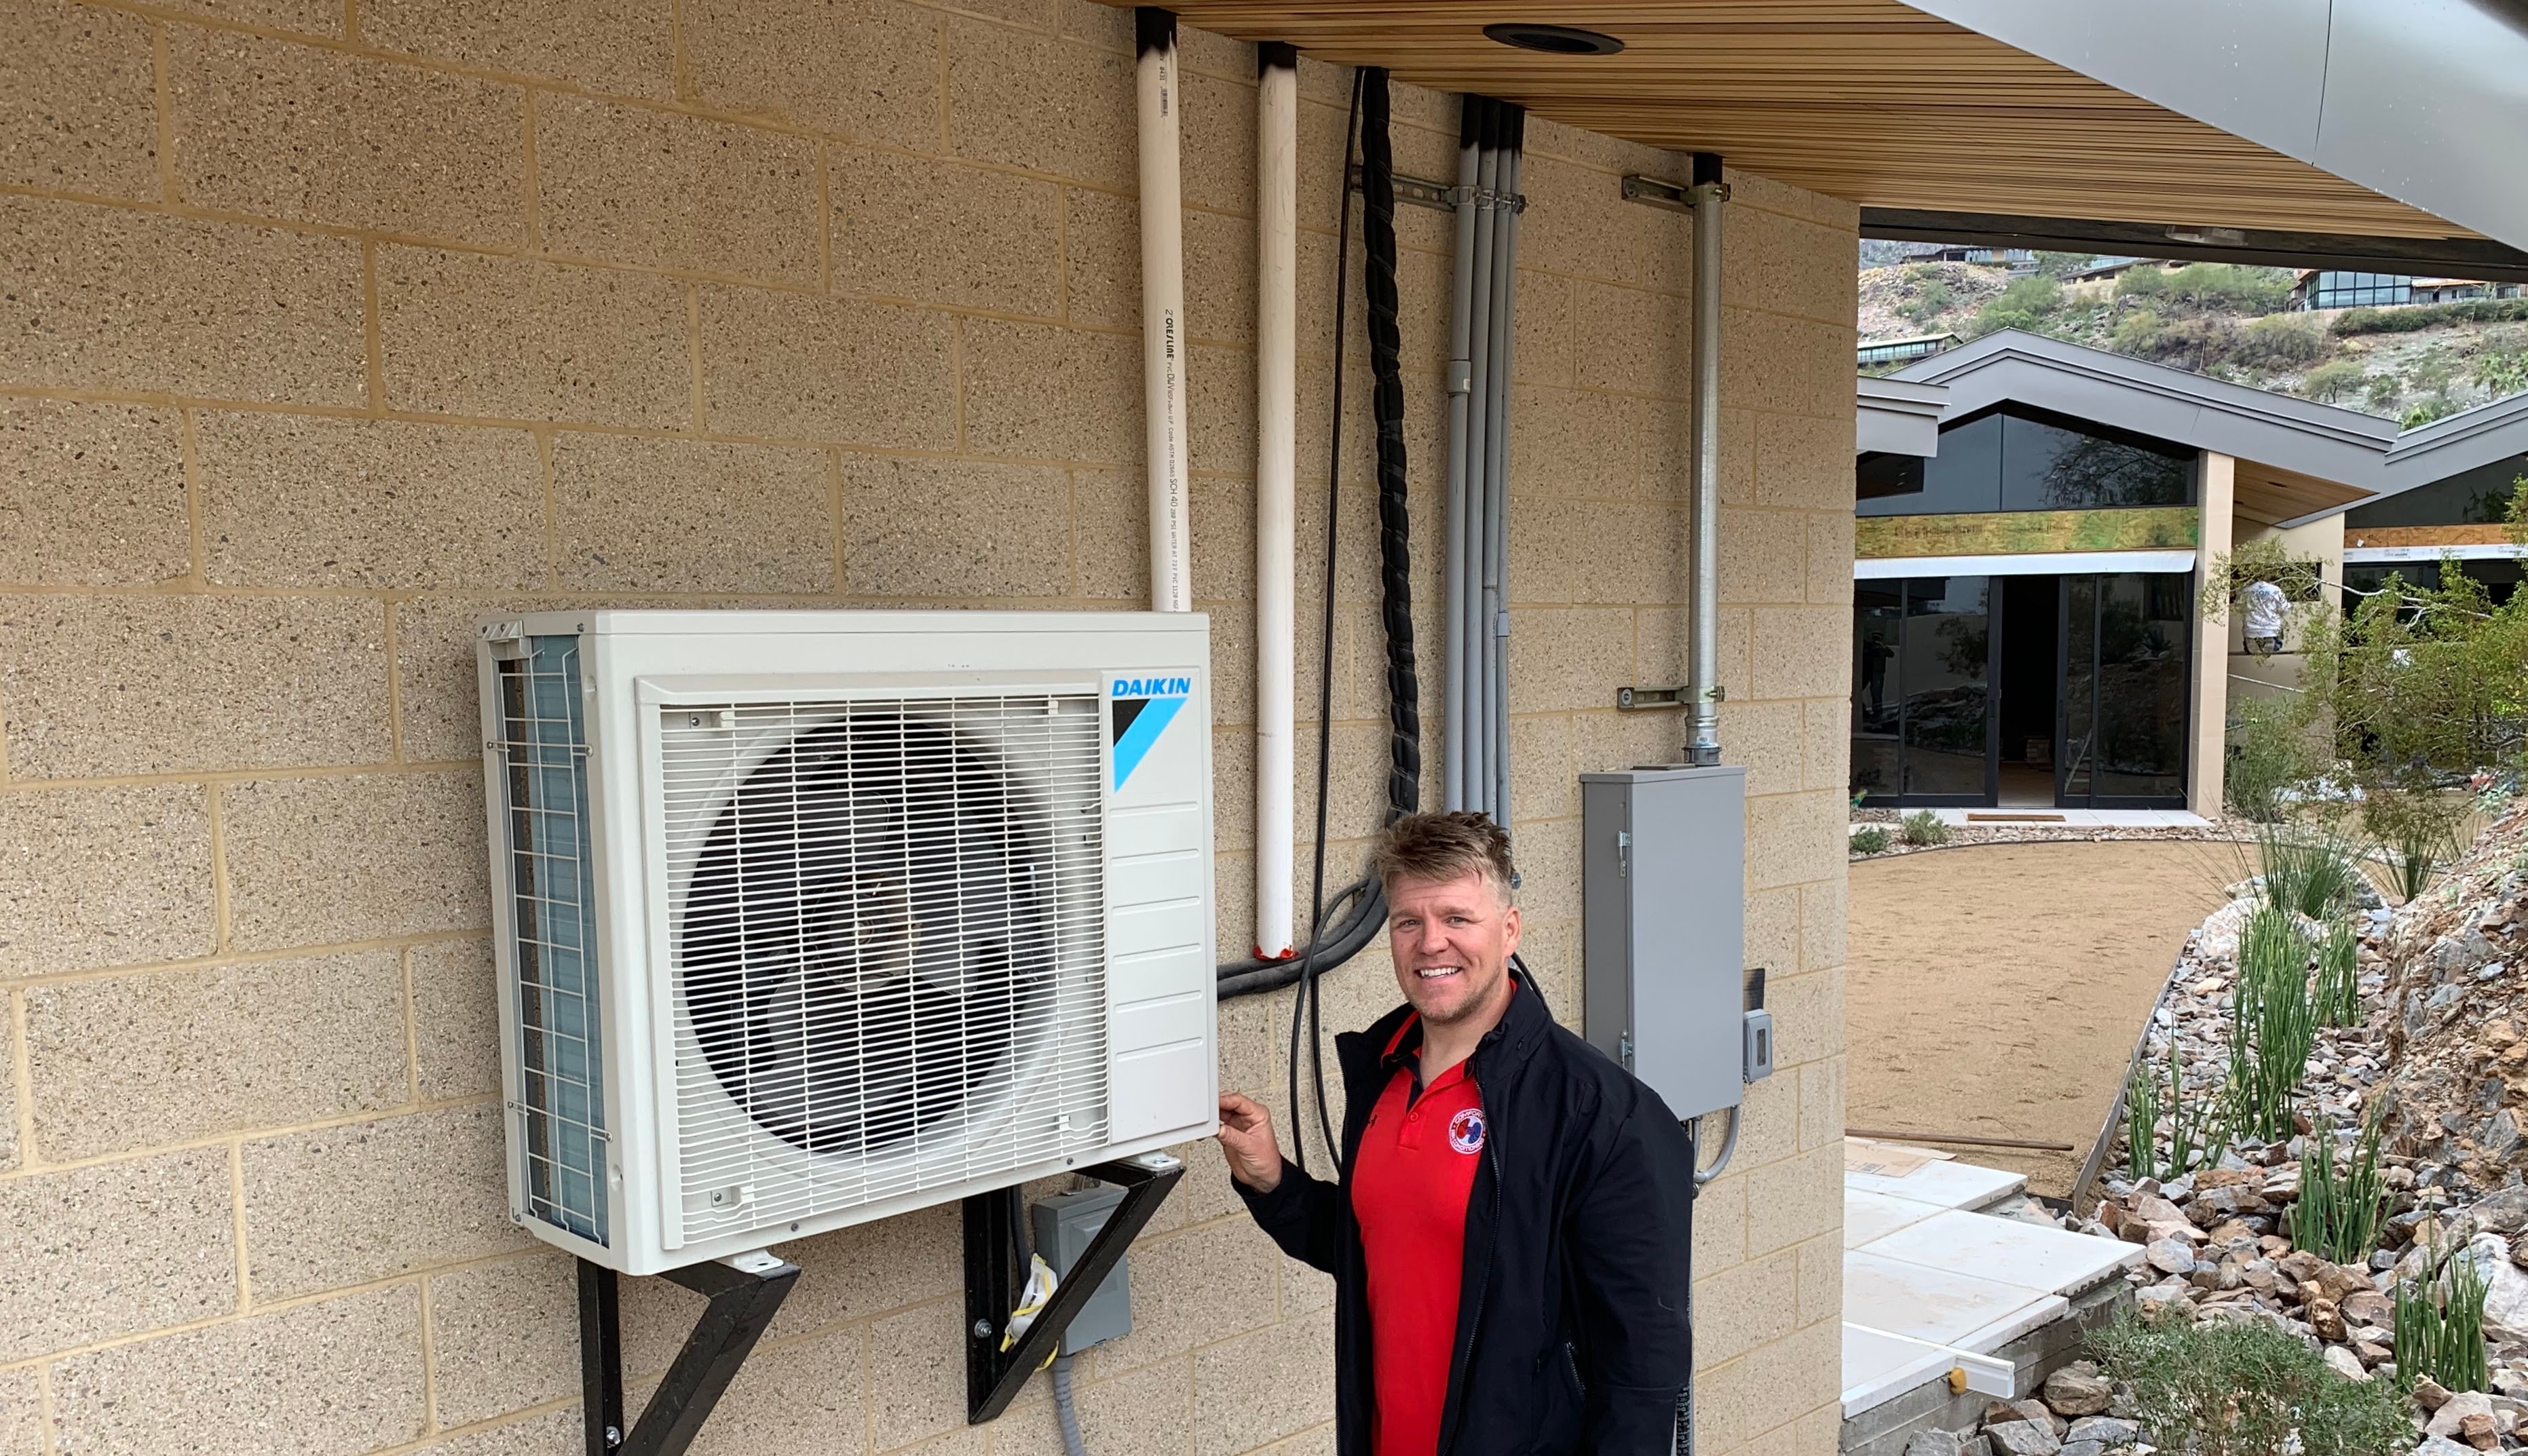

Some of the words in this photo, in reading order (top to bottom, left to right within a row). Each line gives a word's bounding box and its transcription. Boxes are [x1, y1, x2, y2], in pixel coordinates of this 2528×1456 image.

[1167, 373, 1175, 391] DWV
[1169, 478, 1178, 495] SCH
[1170, 495, 1179, 507] 40
[1171, 550, 1177, 559] AT
[1112, 677, 1192, 697] DAIKIN
[1454, 1111, 1483, 1124] COMFORT
